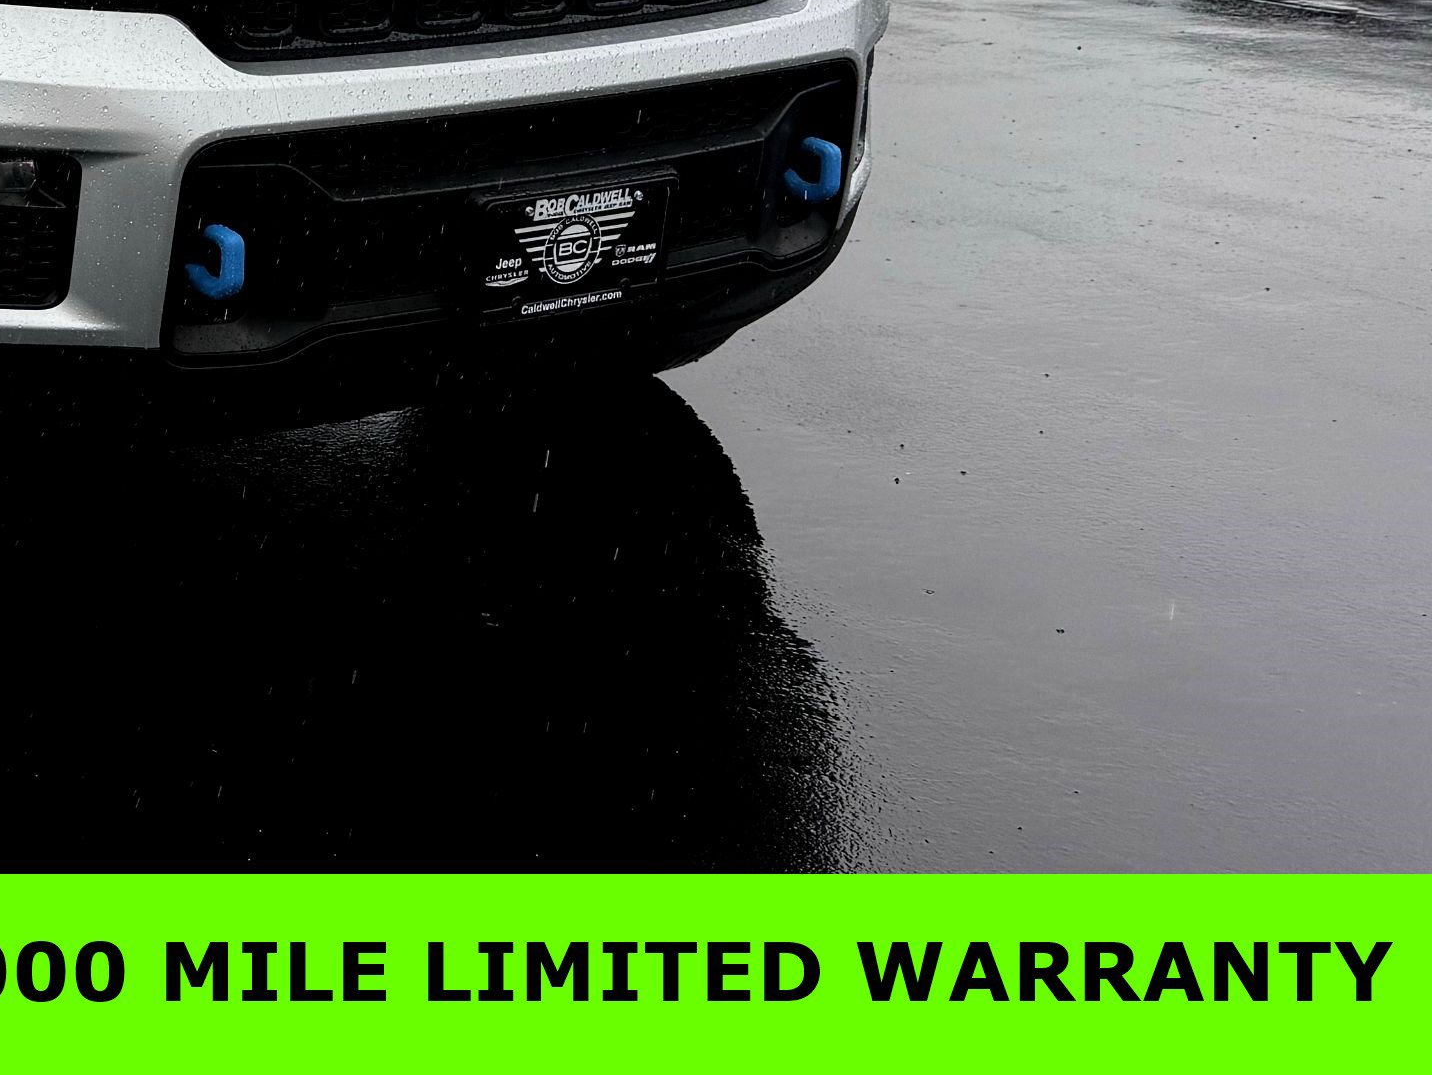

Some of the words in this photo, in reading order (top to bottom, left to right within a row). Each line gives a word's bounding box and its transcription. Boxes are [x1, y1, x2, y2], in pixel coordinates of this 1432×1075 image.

[533, 197, 567, 222] BOB
[565, 188, 632, 216] CALDWELL
[558, 240, 588, 257] BC
[626, 243, 657, 253] RAM
[495, 257, 522, 270] Jeep
[485, 269, 529, 282] CHRYSLER
[521, 290, 623, 315] CaldwellChrysler.com
